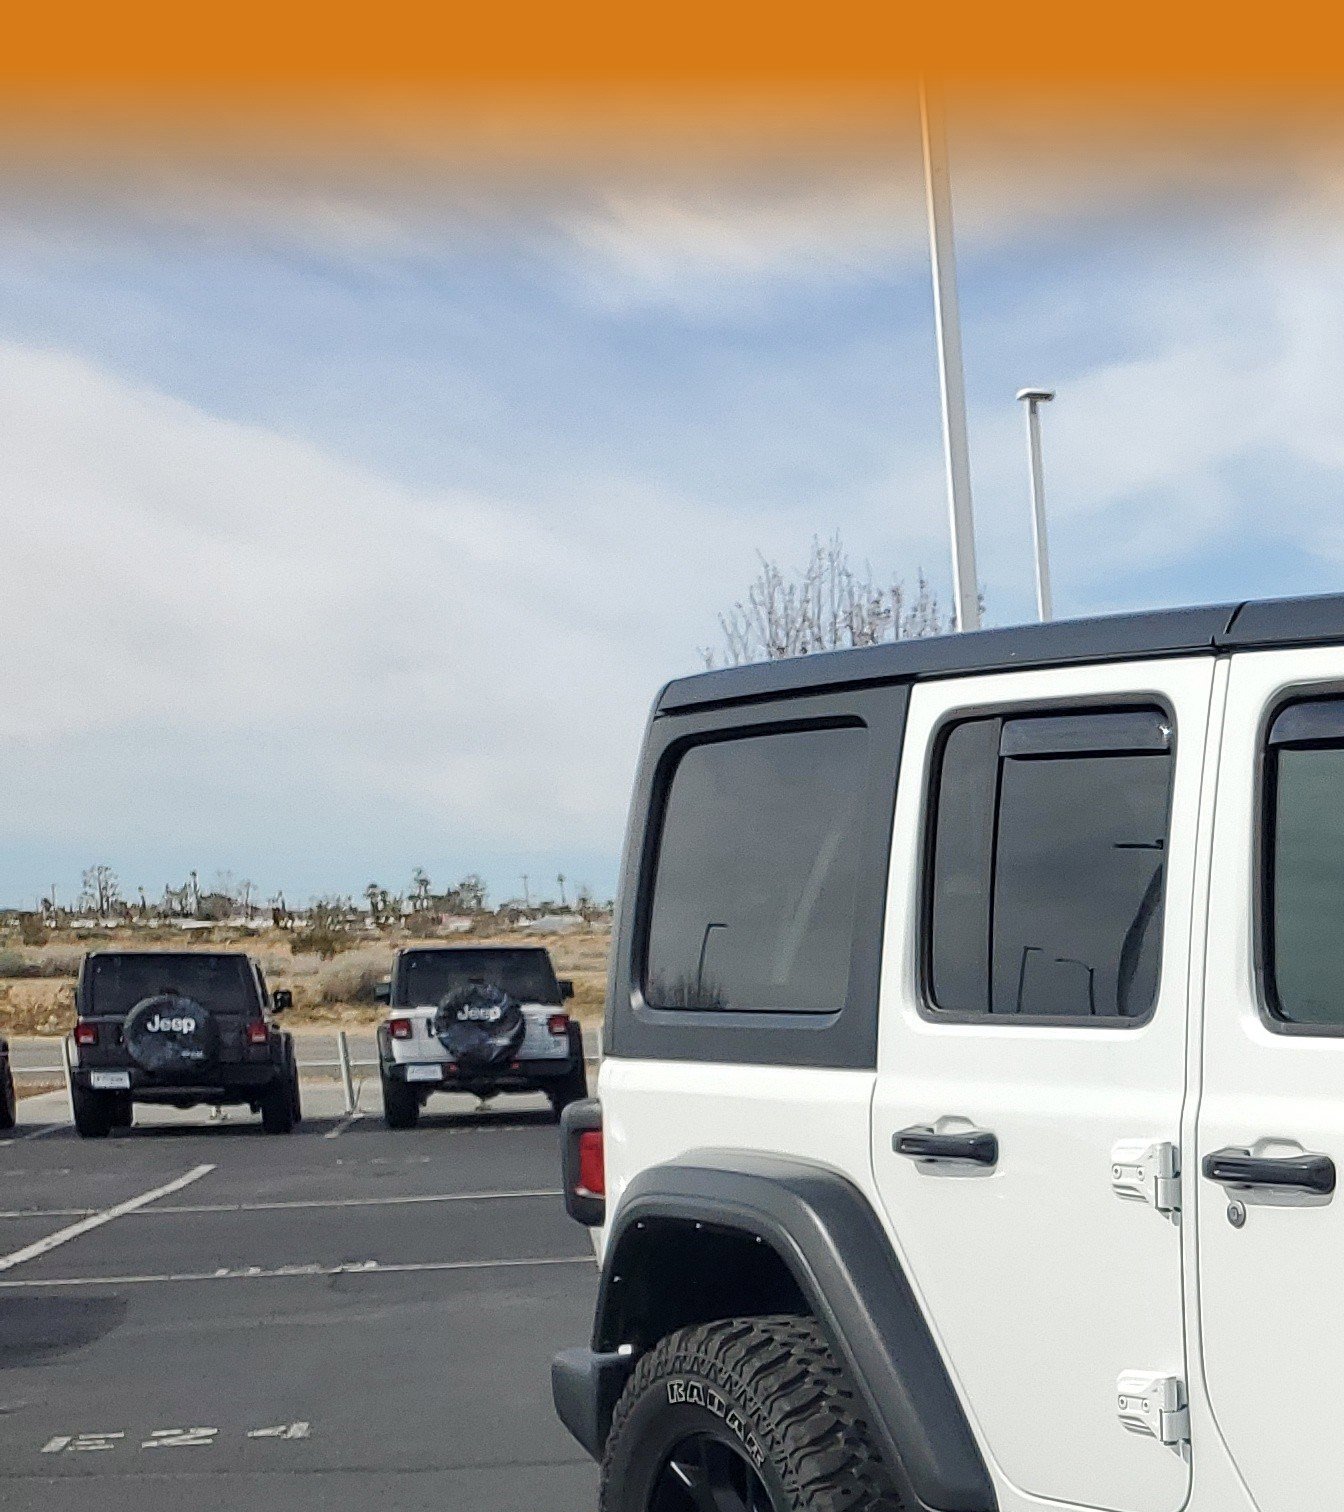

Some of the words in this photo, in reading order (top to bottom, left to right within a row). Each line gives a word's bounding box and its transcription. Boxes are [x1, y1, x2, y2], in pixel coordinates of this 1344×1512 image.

[456, 1003, 502, 1022] Jeep
[145, 1013, 197, 1035] Jeep
[667, 1380, 765, 1468] RADAR
